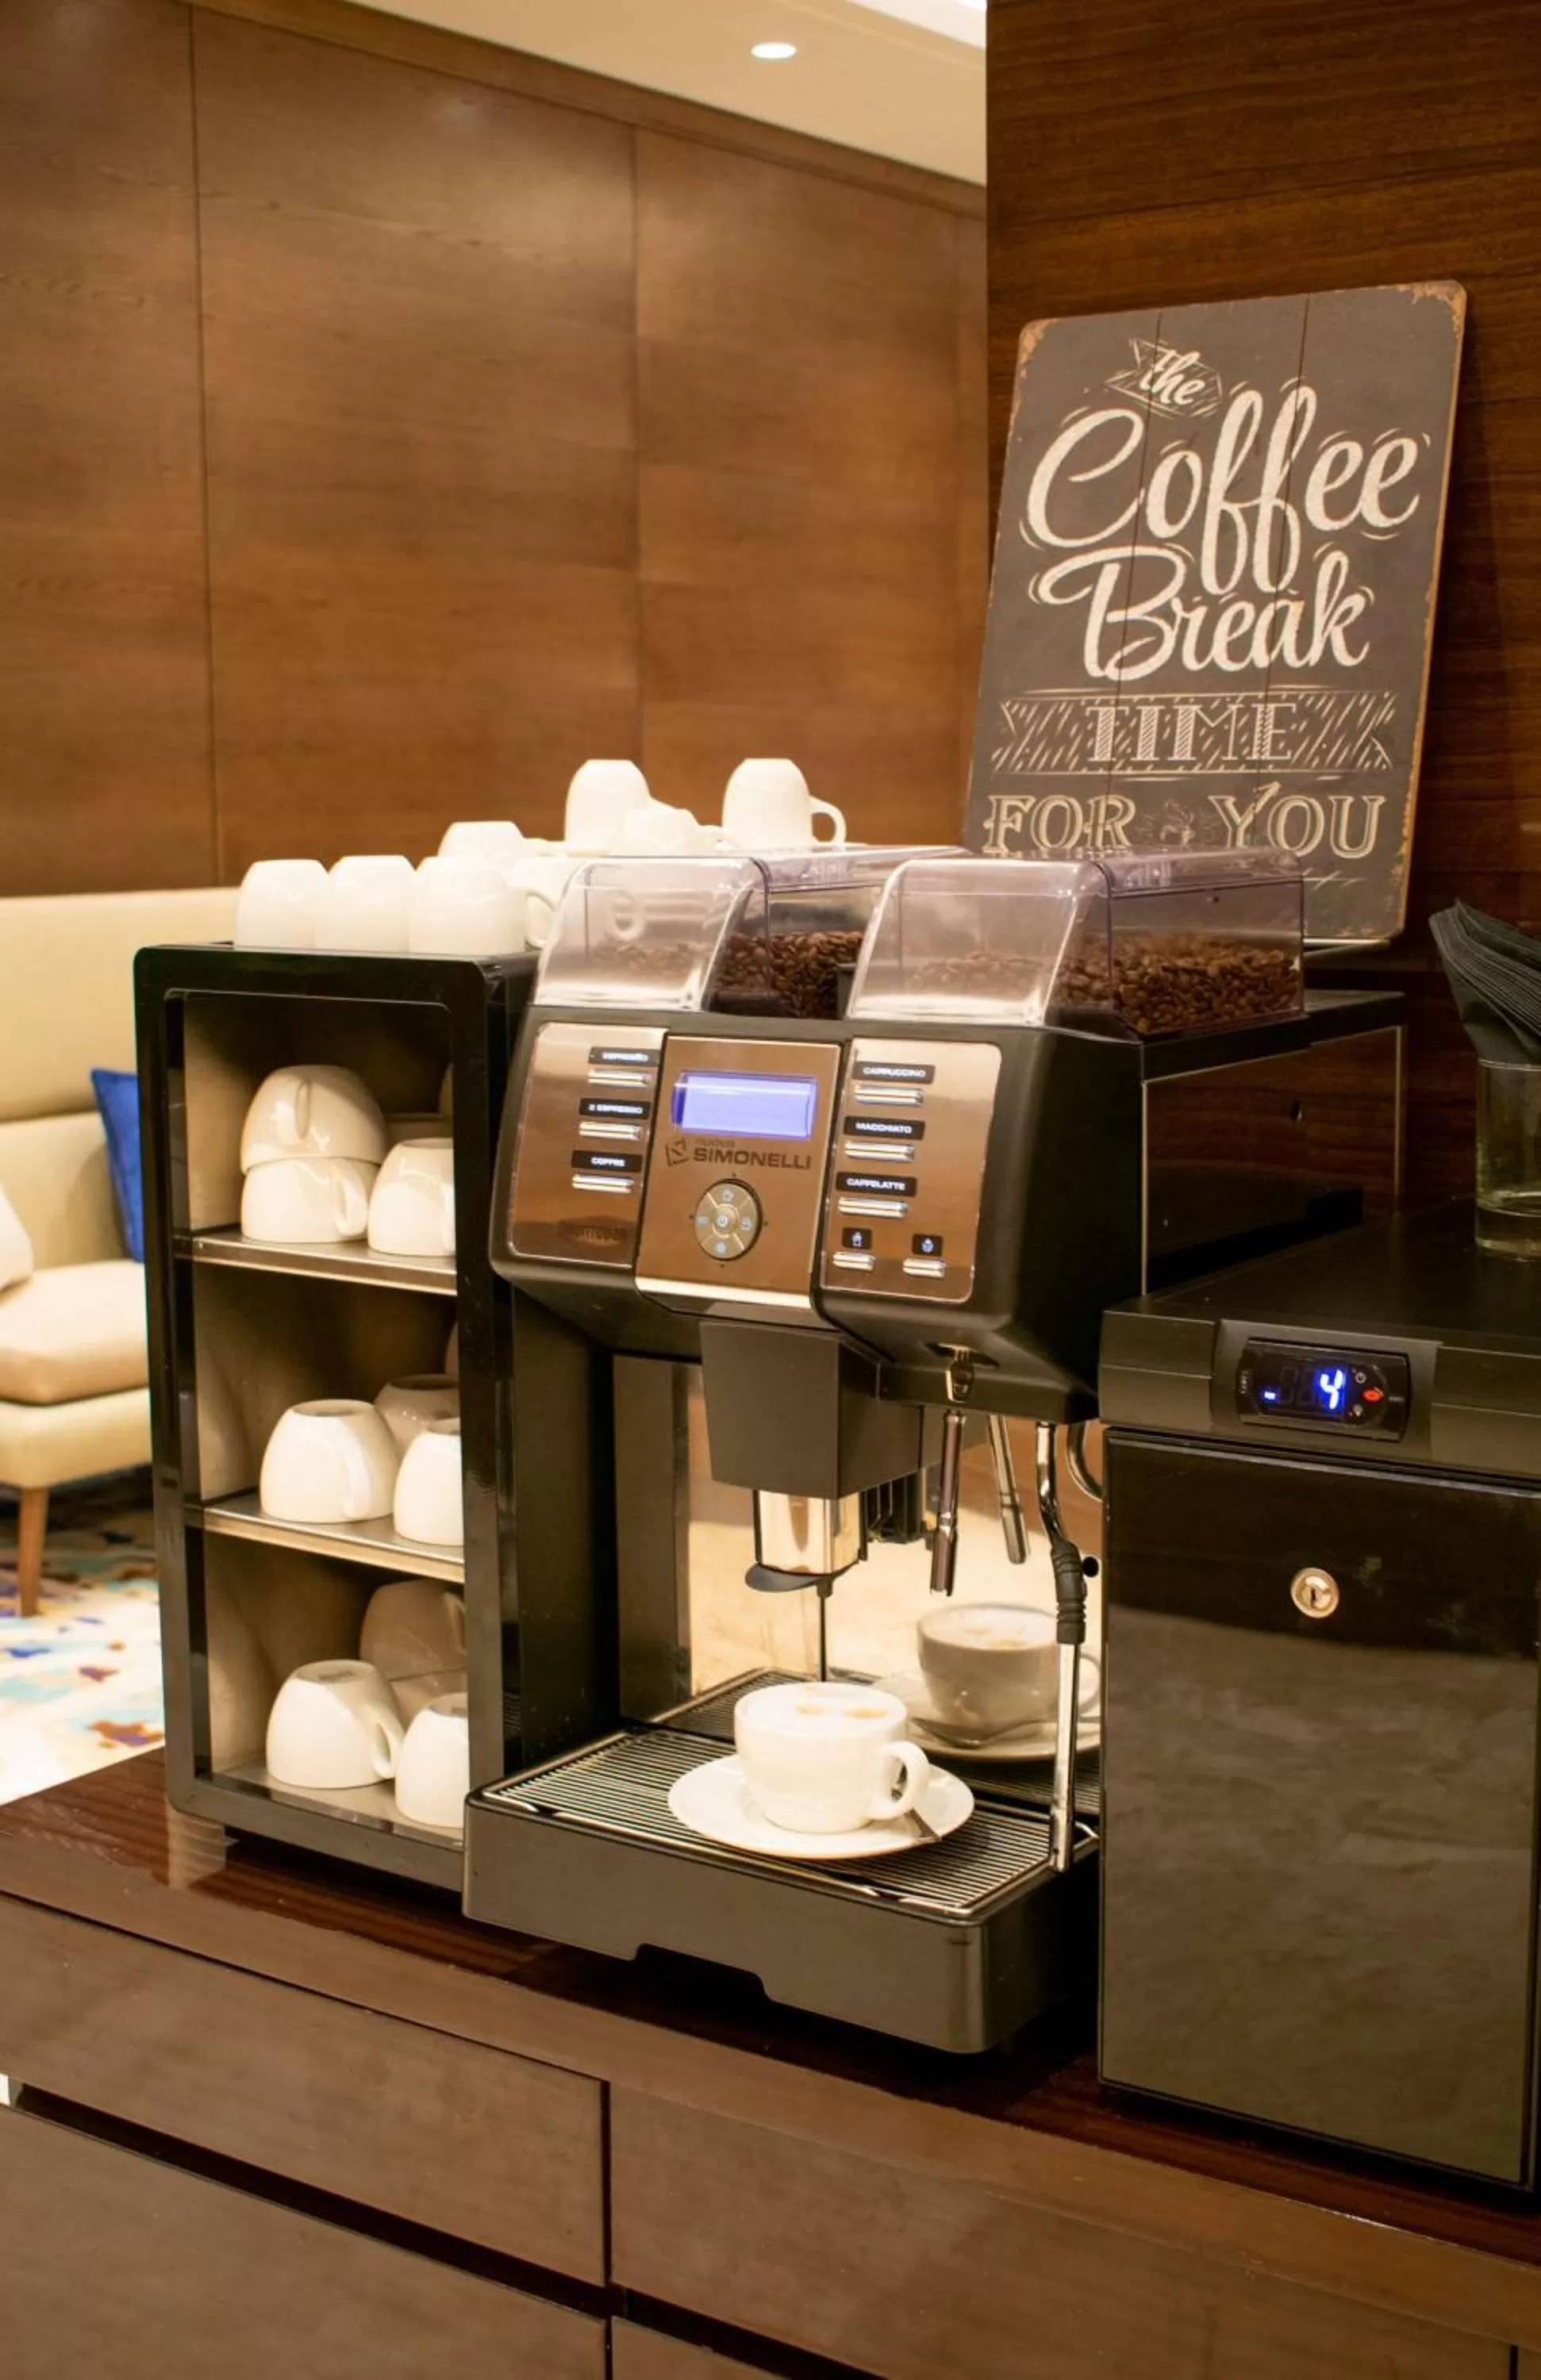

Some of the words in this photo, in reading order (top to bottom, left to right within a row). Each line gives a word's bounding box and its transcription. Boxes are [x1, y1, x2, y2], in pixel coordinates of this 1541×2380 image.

[1139, 350, 1201, 405] the
[1027, 385, 1420, 596] Coffee
[1037, 545, 1370, 681] Break
[1086, 702, 1297, 762] TIME
[982, 794, 1136, 856] FOR
[1208, 781, 1386, 859] YOU
[863, 1067, 927, 1077] CAPPUCCINO
[597, 1104, 644, 1115] ESPRESSO
[855, 1122, 913, 1134] MACCHIATO
[591, 1157, 625, 1167] COFFEE
[693, 1148, 812, 1169] SIMONELLI
[1320, 1369, 1343, 1410] 4
